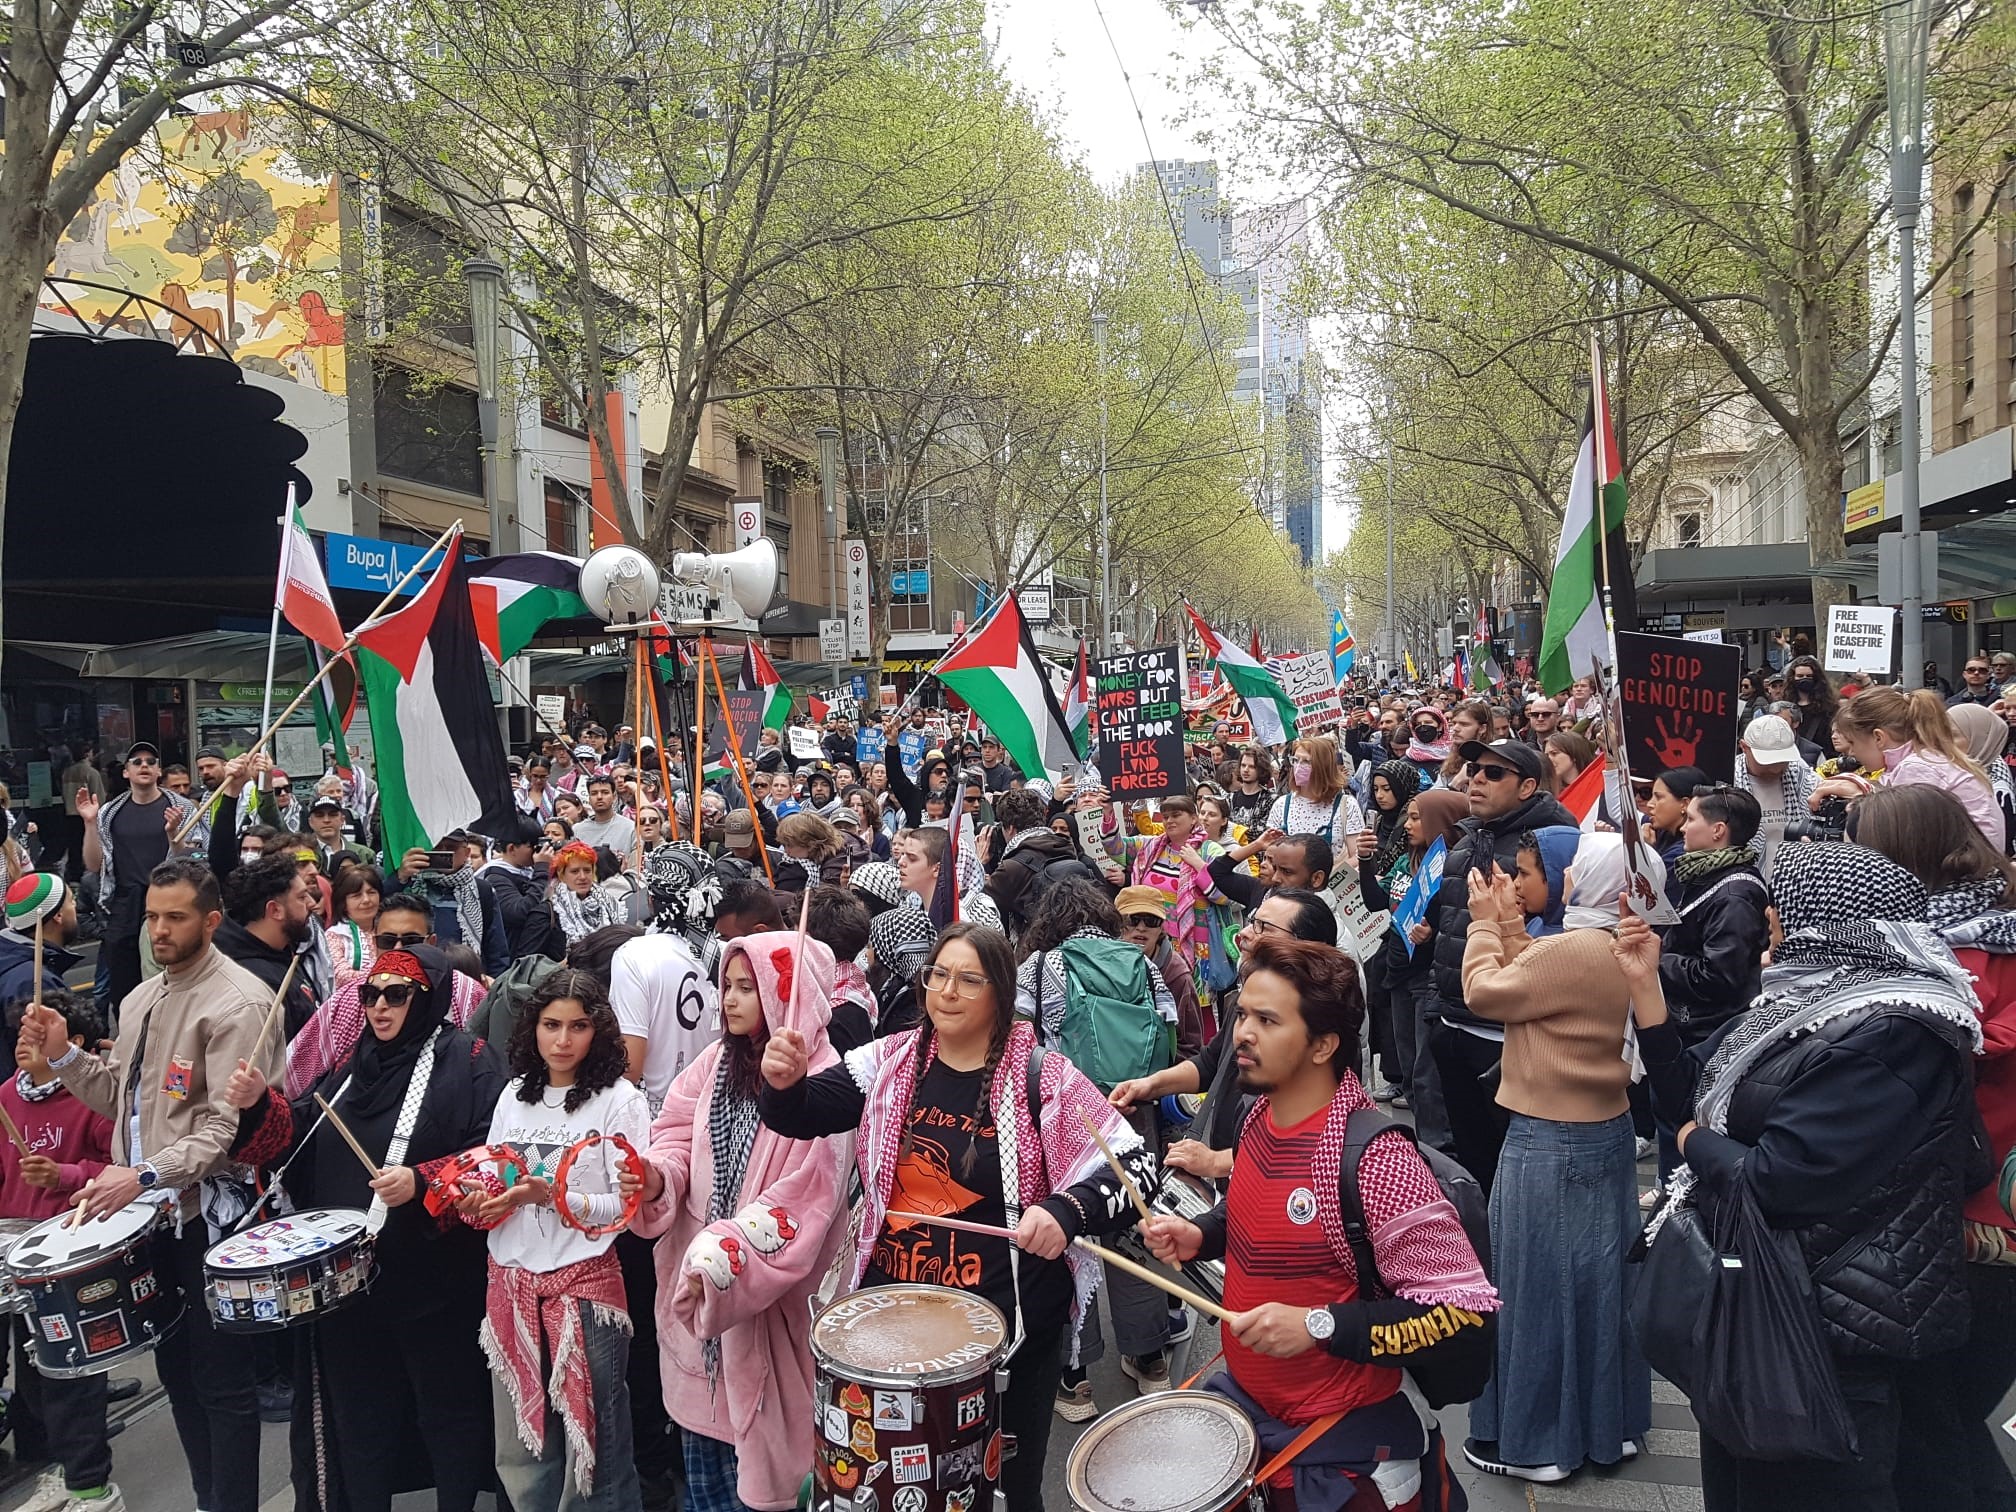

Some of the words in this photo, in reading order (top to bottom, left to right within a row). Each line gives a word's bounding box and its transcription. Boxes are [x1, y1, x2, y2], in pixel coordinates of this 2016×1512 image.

[180, 48, 206, 65] 198
[346, 543, 385, 571] Bupa
[1027, 596, 1048, 604] LEASE
[1693, 617, 1725, 626] SOUVENIR
[1835, 610, 1859, 621] FREE
[1834, 622, 1887, 637] PALESTINE,
[1833, 635, 1884, 648] CEASEFIRE
[1099, 656, 1135, 676] THEY
[1138, 652, 1166, 670] GOT
[1832, 648, 1857, 660] NOW.
[1650, 652, 1702, 682] STOP
[1098, 672, 1144, 693] MONEY
[1147, 668, 1176, 686] FOR
[730, 697, 752, 709] STOP
[1140, 686, 1170, 705] BUT
[1624, 677, 1727, 716] GENOCIDE
[1101, 707, 1137, 726] CANT
[1140, 701, 1180, 720] FEED
[1295, 707, 1343, 728] LIBERATION
[1302, 701, 1330, 714] UNTIL
[1103, 725, 1132, 742] THE
[1137, 720, 1175, 739] POOR
[1120, 739, 1158, 759] FUCK
[1111, 771, 1168, 791] FORCES
[1363, 913, 1385, 935] MINUTES
[676, 971, 705, 1031] 6
[131, 1273, 156, 1293] FCK
[957, 1392, 986, 1416] FCK
[957, 1406, 986, 1431] IDF
